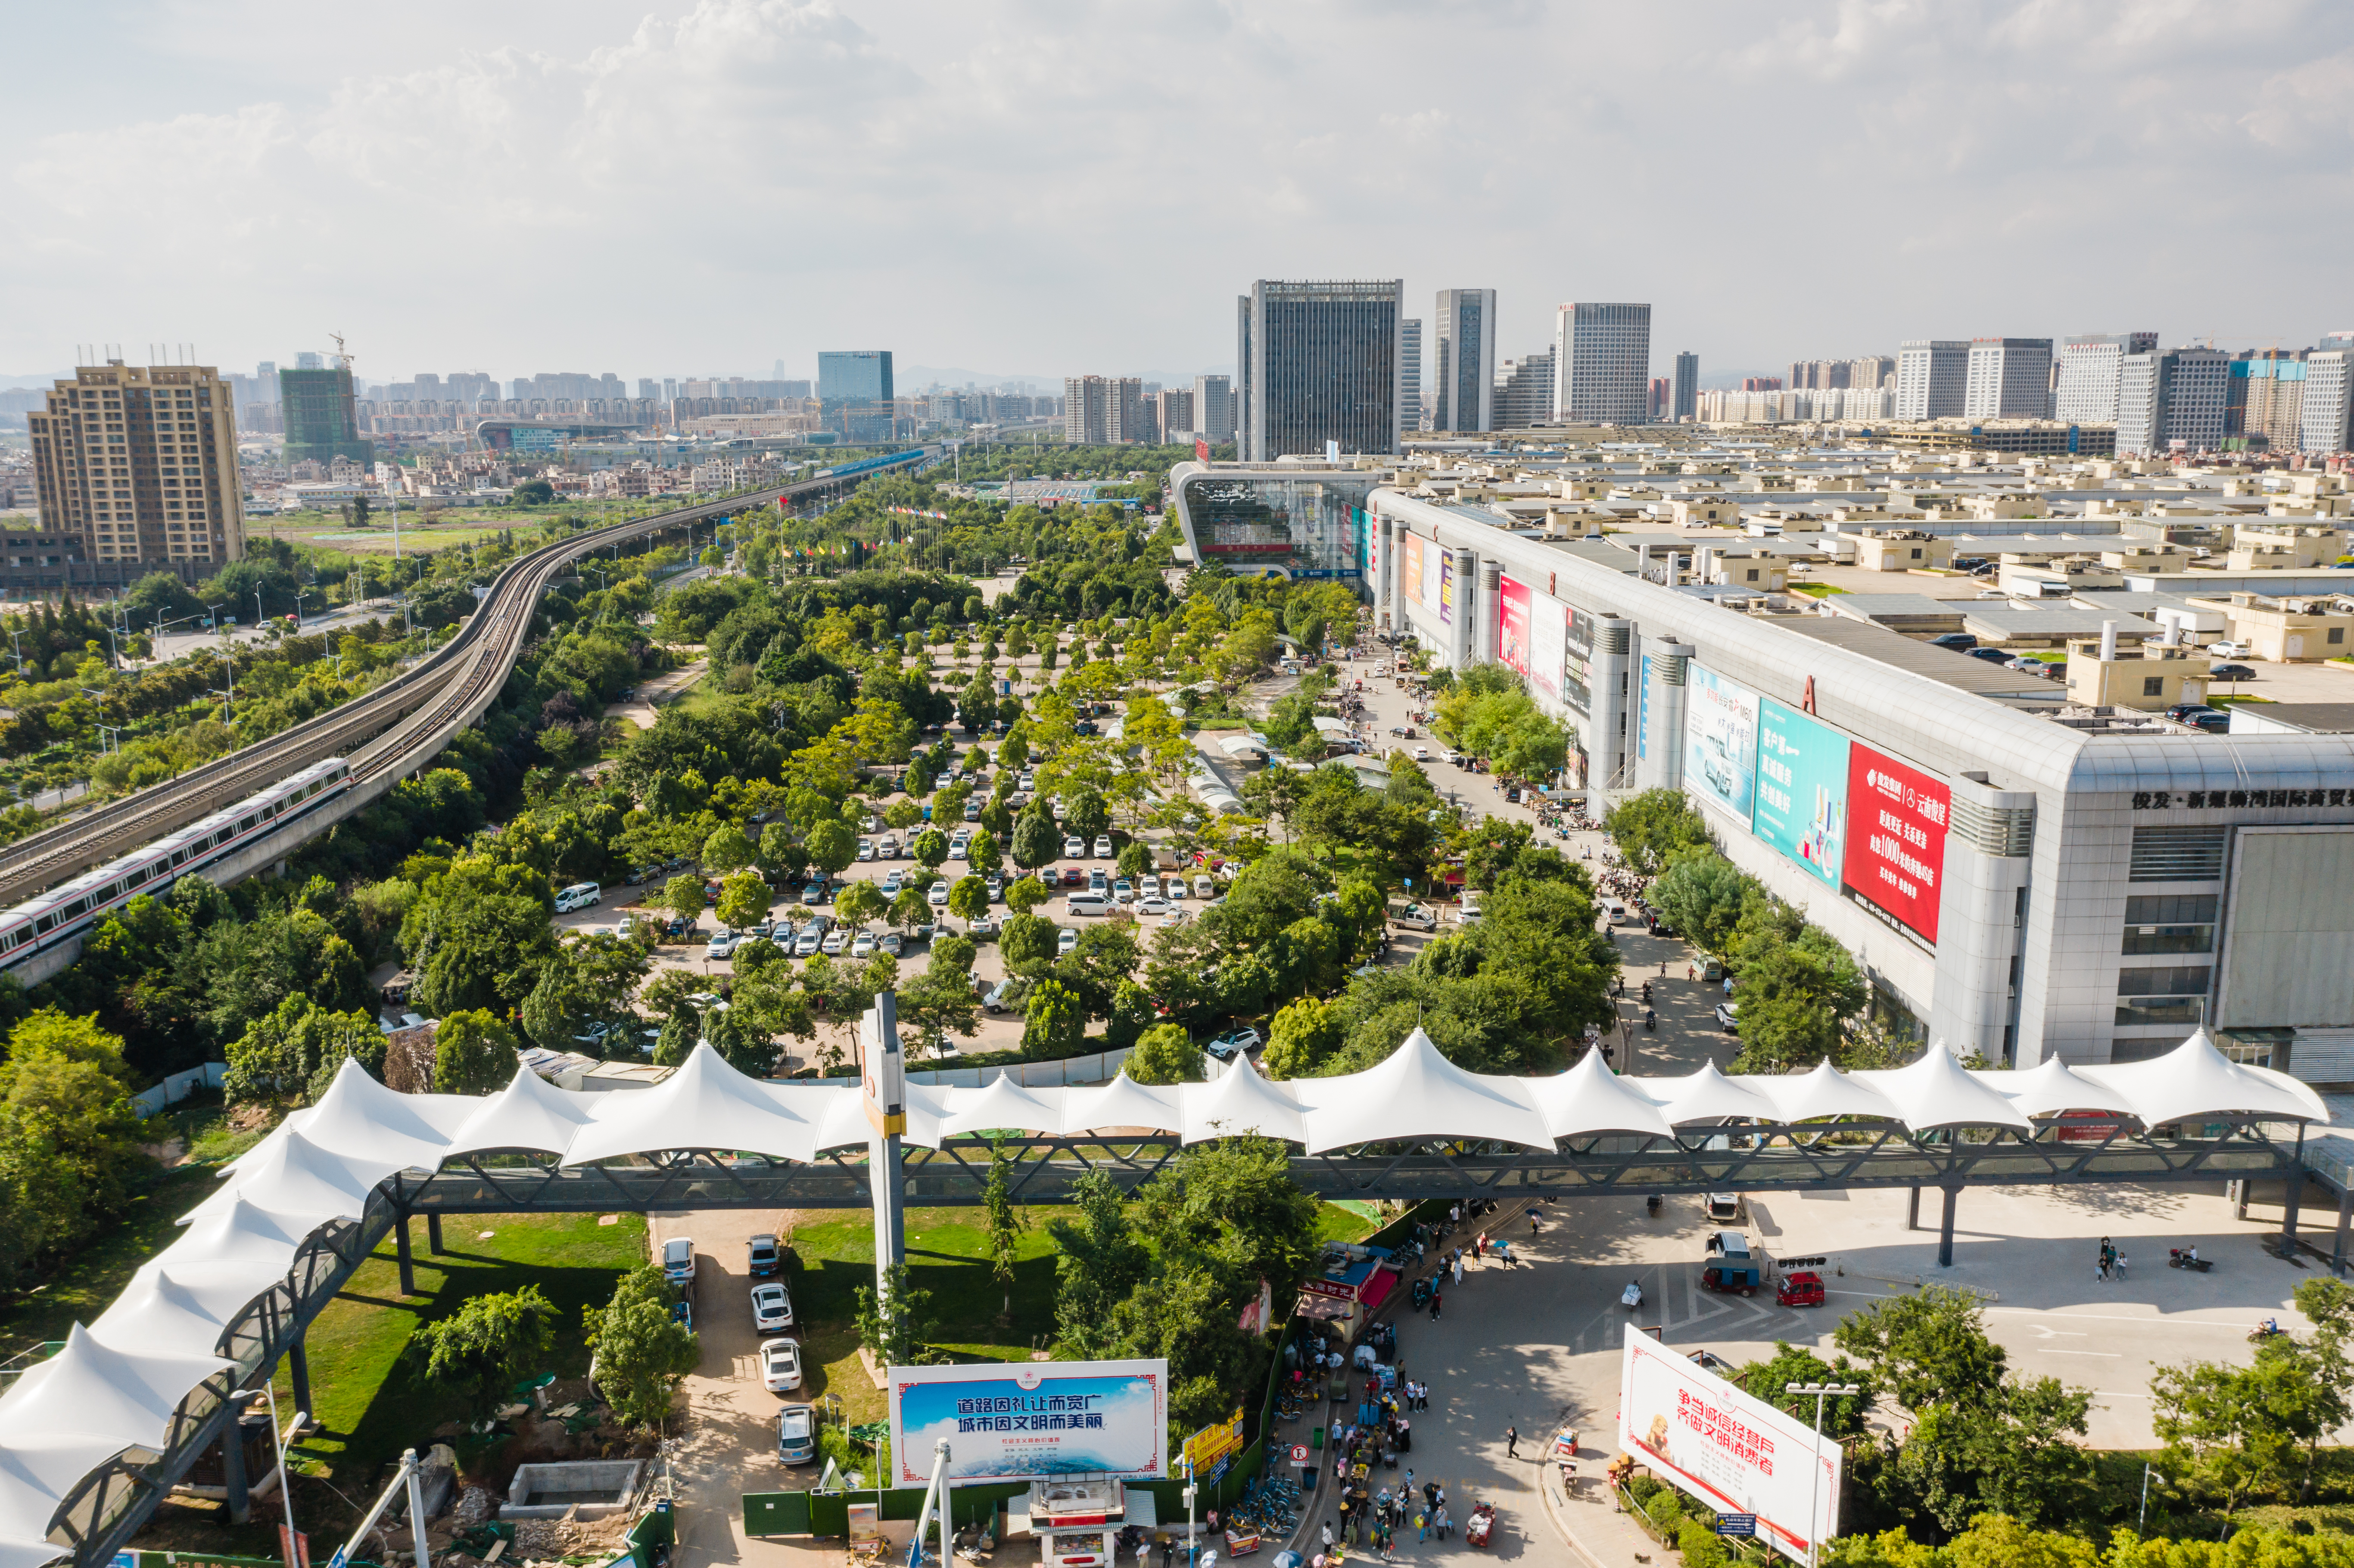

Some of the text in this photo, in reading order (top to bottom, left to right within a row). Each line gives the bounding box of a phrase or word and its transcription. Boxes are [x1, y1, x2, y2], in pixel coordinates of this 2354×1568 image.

[1433, 524, 1438, 542] C
[1550, 571, 1556, 596] B
[1707, 688, 1718, 704] 多功能
[1740, 705, 1752, 722] M60
[1801, 675, 1816, 715] A
[1764, 728, 1800, 756] 客户第一
[1762, 754, 1792, 787] 真诚服务
[1760, 780, 1790, 814] 共创美好
[1877, 772, 1901, 795] 俊发集团
[1918, 794, 1946, 826] 云南俊星
[1879, 809, 1902, 836] 距离更近
[957, 1394, 1102, 1414] 道路因礼让而宽广
[959, 1413, 1102, 1432] 城市因文明而美丽
[1678, 1388, 1774, 1454] 争当诚信经营户
[1677, 1405, 1773, 1476] 齐做文明消费者
